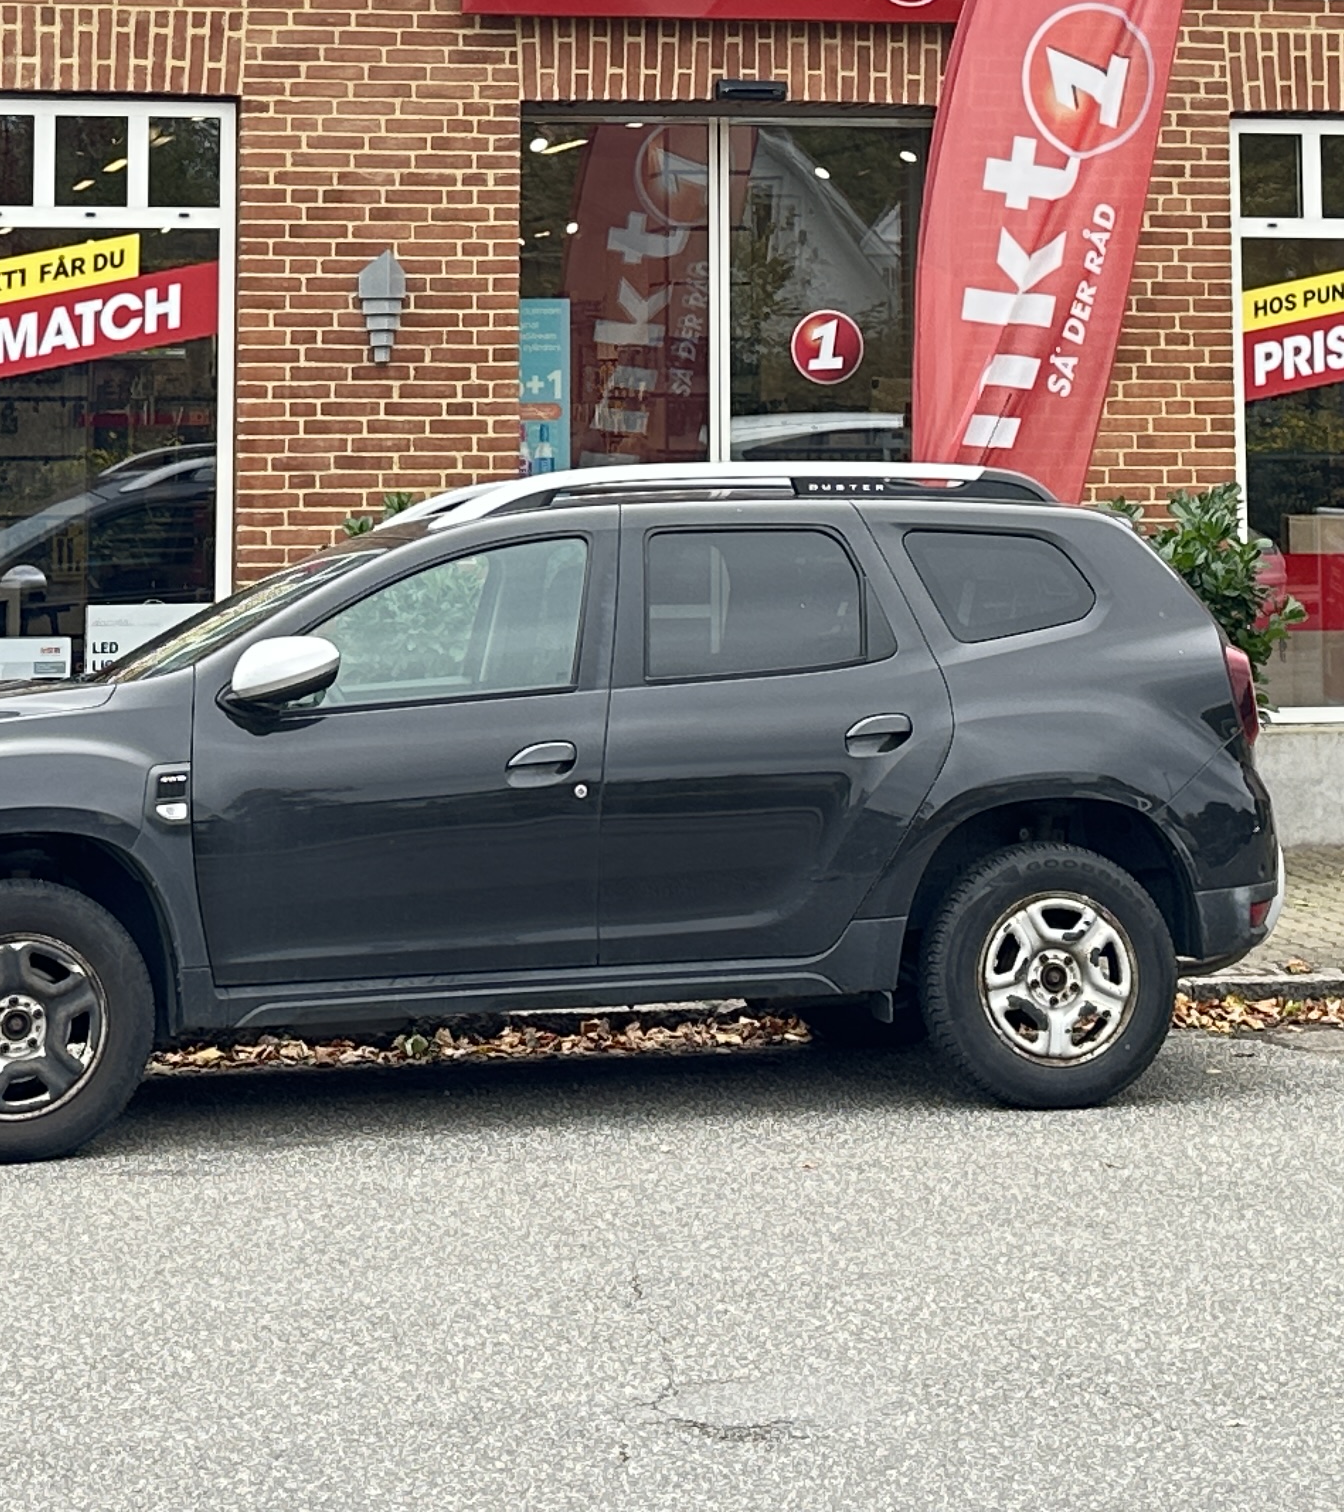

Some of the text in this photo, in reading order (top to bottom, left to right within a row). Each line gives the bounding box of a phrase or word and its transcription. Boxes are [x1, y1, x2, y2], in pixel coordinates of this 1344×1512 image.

[39, 255, 87, 284] FÅR
[93, 249, 126, 274] DU
[1048, 202, 1116, 399] SÅ DER RÅD
[1253, 293, 1298, 319] HOS
[807, 318, 844, 371] 1
[807, 482, 885, 492] DUSTER
[92, 641, 119, 654] LED
